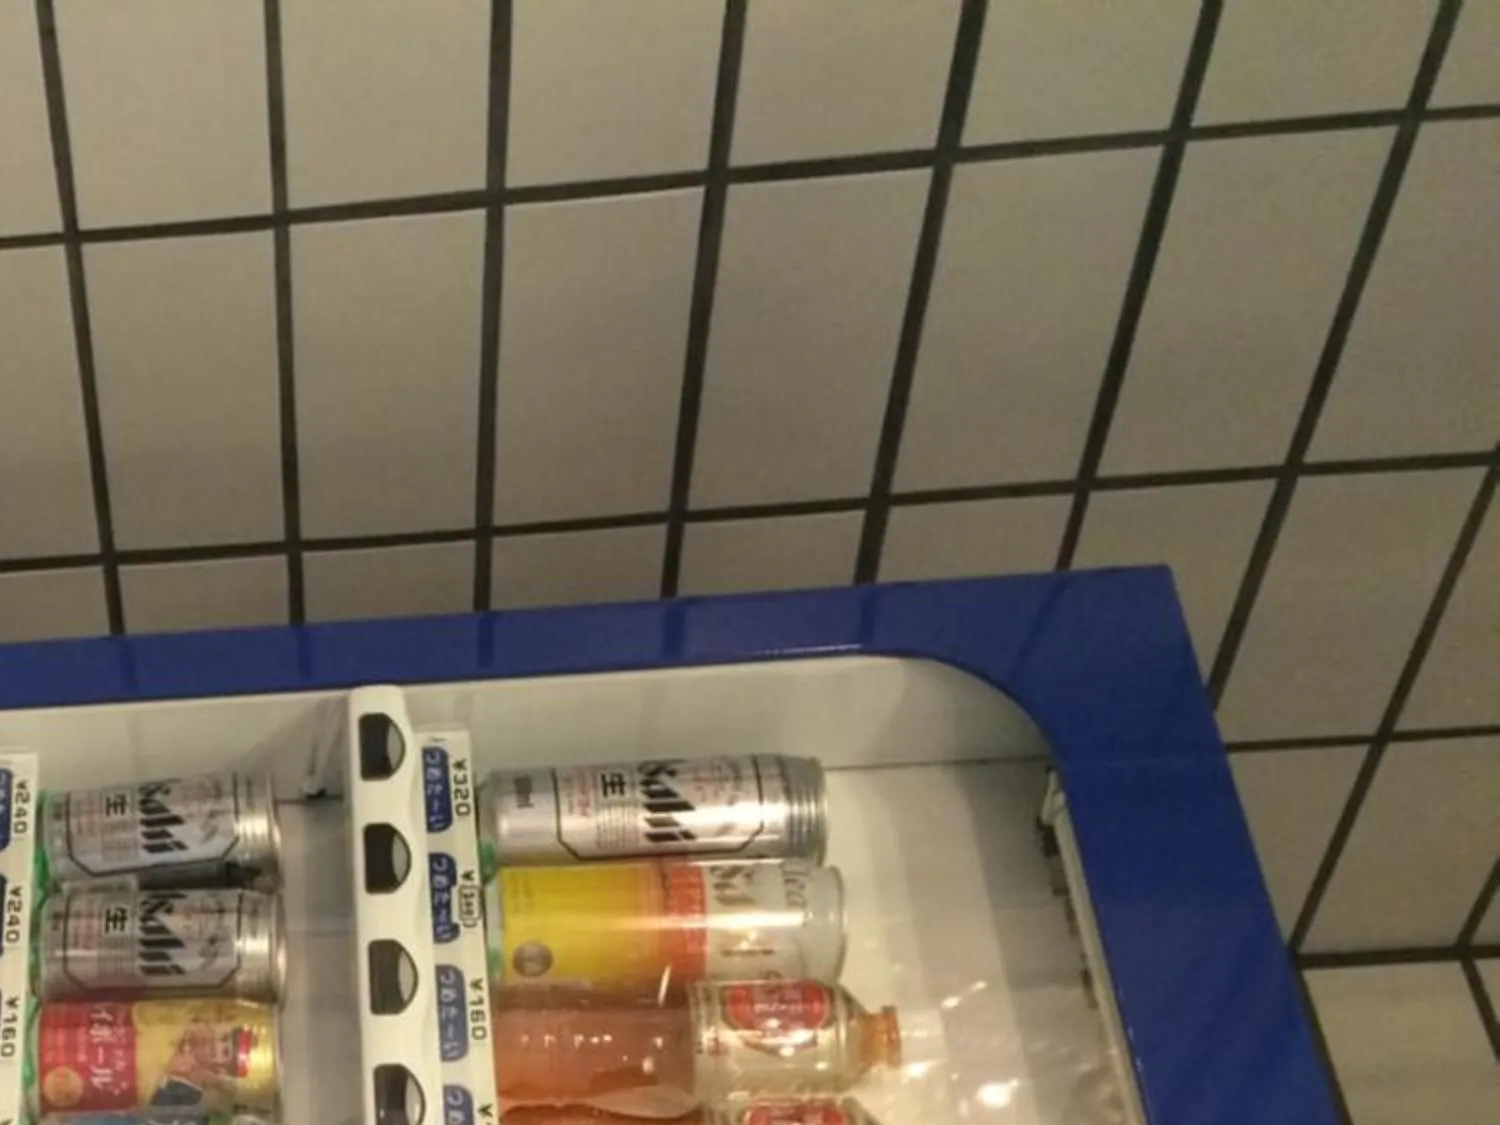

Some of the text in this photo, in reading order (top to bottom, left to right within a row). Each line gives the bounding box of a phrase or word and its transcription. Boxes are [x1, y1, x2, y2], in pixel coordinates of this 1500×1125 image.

[13, 779, 31, 834] ¥240
[106, 793, 128, 817] 生
[452, 757, 471, 817] ¥320
[601, 772, 627, 798] 生
[638, 759, 697, 843] sahi
[138, 778, 190, 854] sahi
[5, 885, 23, 944] ¥240
[105, 906, 129, 935] 生
[0, 995, 19, 1058] ¥160
[469, 977, 488, 1041] ¥160
[89, 1003, 115, 1090] イボール
